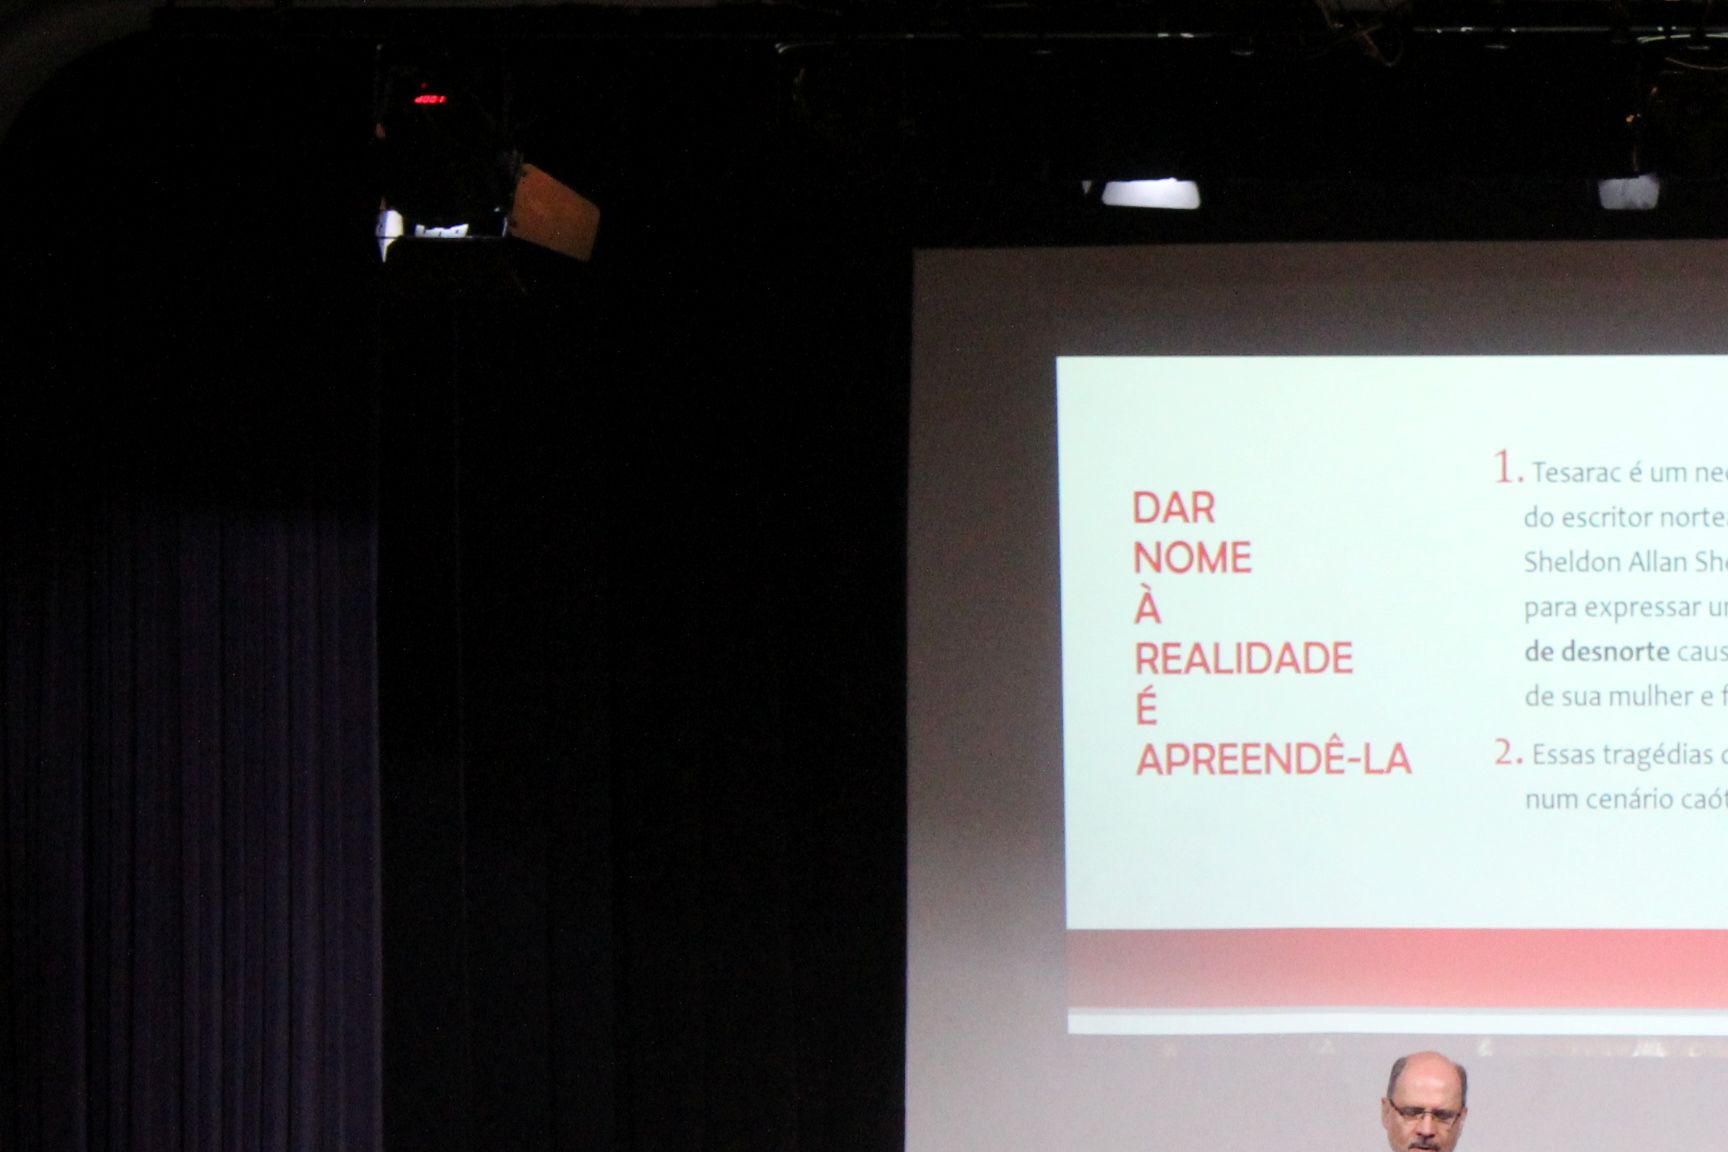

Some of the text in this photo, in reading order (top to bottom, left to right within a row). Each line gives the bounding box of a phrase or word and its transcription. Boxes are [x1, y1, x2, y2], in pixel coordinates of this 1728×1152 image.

[1494, 448, 1524, 484] 1.
[1532, 460, 1622, 484] Tesarac
[1629, 459, 1643, 483] é
[1650, 466, 1688, 483] um
[1132, 489, 1216, 525] DAR
[1523, 504, 1555, 528] do
[1561, 505, 1654, 529] escritor
[1133, 539, 1253, 575] NOME
[1524, 549, 1622, 573] Sheldon
[1628, 549, 1688, 573] Allan
[1133, 582, 1163, 625] À
[1524, 600, 1578, 623] para
[1584, 600, 1702, 623] expressar
[1135, 640, 1354, 676] REALIDADE
[1524, 638, 1555, 663] de
[1560, 638, 1671, 663] desnorte
[1135, 684, 1158, 726] É
[1524, 683, 1555, 707] de
[1562, 689, 1602, 707] sua
[1608, 683, 1695, 707] mulher
[1700, 690, 1715, 707] e
[1135, 732, 1413, 776] APREENDÊ-LA
[1495, 737, 1524, 765] 2.
[1533, 742, 1596, 765] Essas
[1602, 741, 1714, 773] tragédias
[1525, 792, 1579, 810] num
[1585, 787, 1674, 810] cenário
